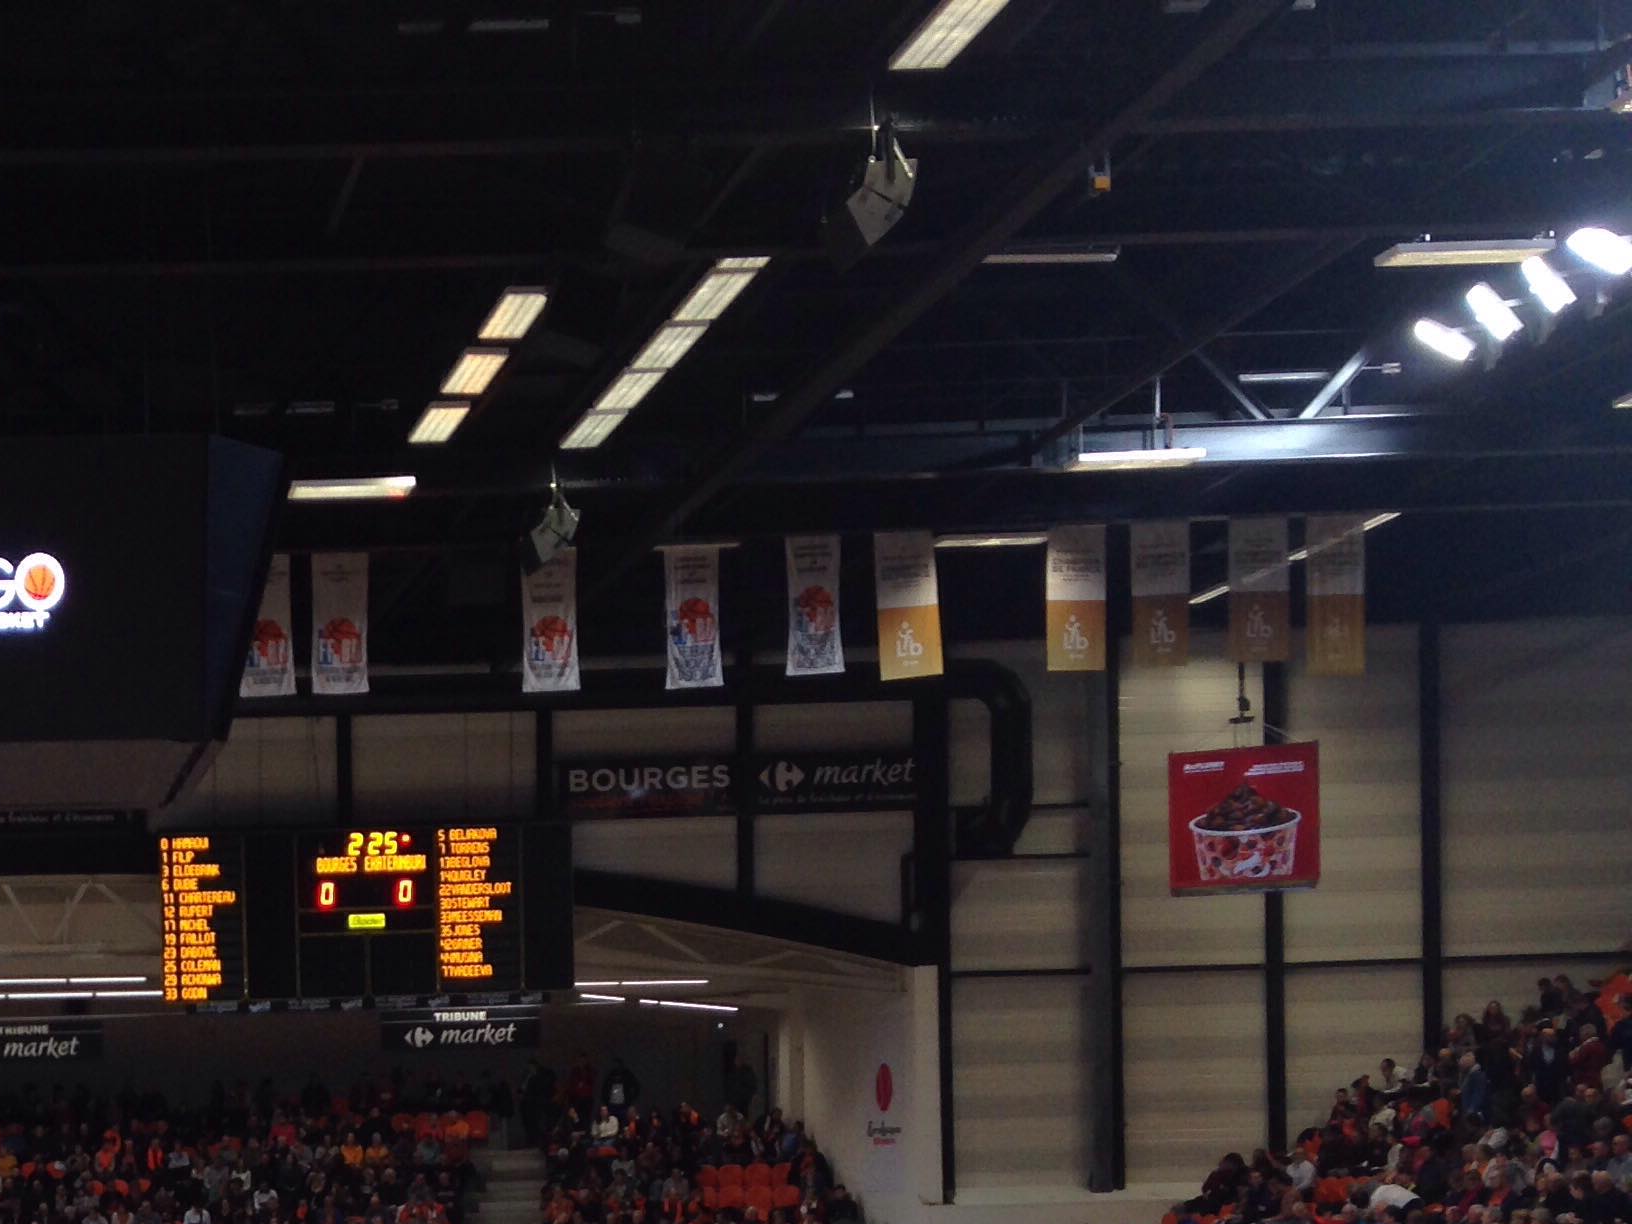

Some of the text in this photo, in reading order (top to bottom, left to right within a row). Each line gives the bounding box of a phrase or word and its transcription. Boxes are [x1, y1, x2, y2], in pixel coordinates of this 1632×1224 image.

[568, 765, 731, 793] BOURGES
[813, 757, 917, 786] market
[438, 829, 445, 841] 5
[163, 893, 174, 904] 11
[320, 879, 413, 906] 0 0
[433, 1011, 488, 1022] TRIBUNE
[440, 1022, 517, 1045] market
[3, 1036, 80, 1059] market
